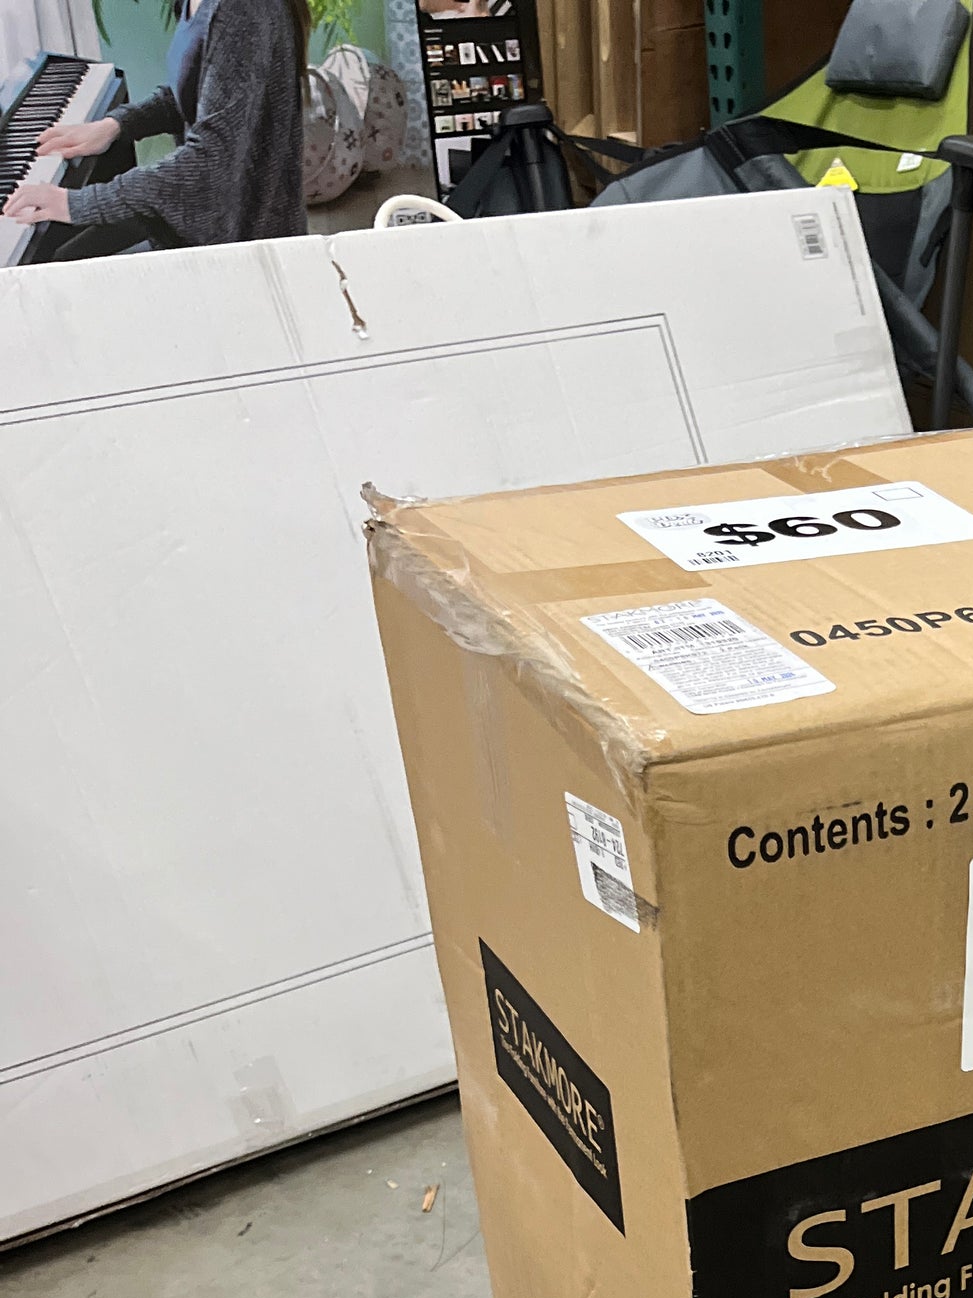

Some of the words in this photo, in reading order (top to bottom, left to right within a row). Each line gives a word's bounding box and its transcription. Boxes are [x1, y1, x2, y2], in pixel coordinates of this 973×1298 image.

[703, 509, 902, 547] $60
[696, 549, 733, 558] 8201
[727, 801, 911, 869] Contents
[949, 782, 970, 824] 2
